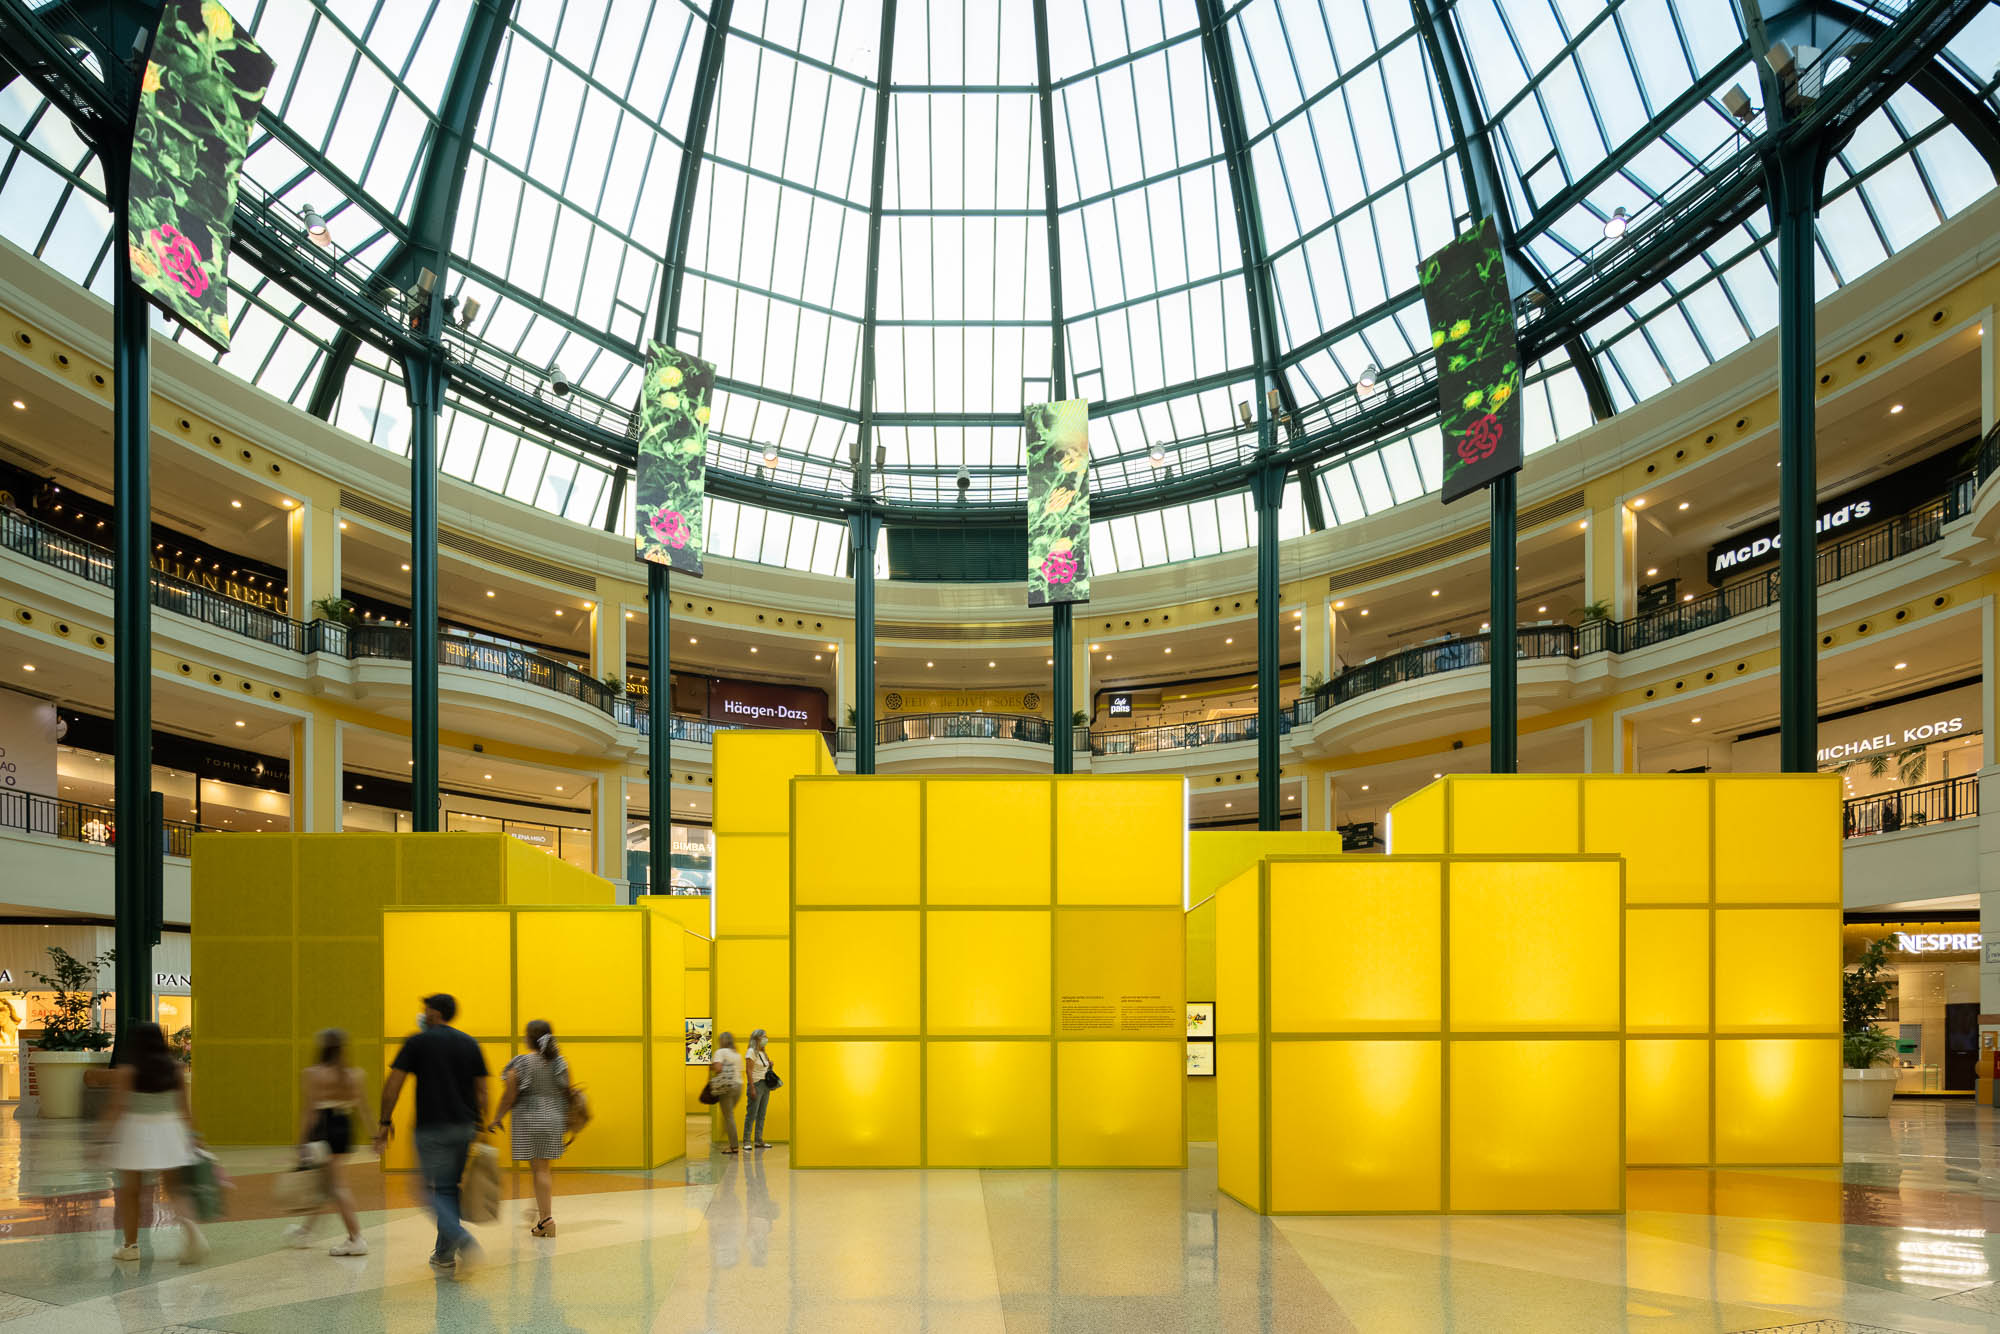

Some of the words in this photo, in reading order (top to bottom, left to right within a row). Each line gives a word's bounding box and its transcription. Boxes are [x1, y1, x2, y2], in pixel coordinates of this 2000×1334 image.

[1903, 717, 1963, 743] KORS
[672, 841, 706, 852] BIMBA
[156, 972, 192, 987] PAN
